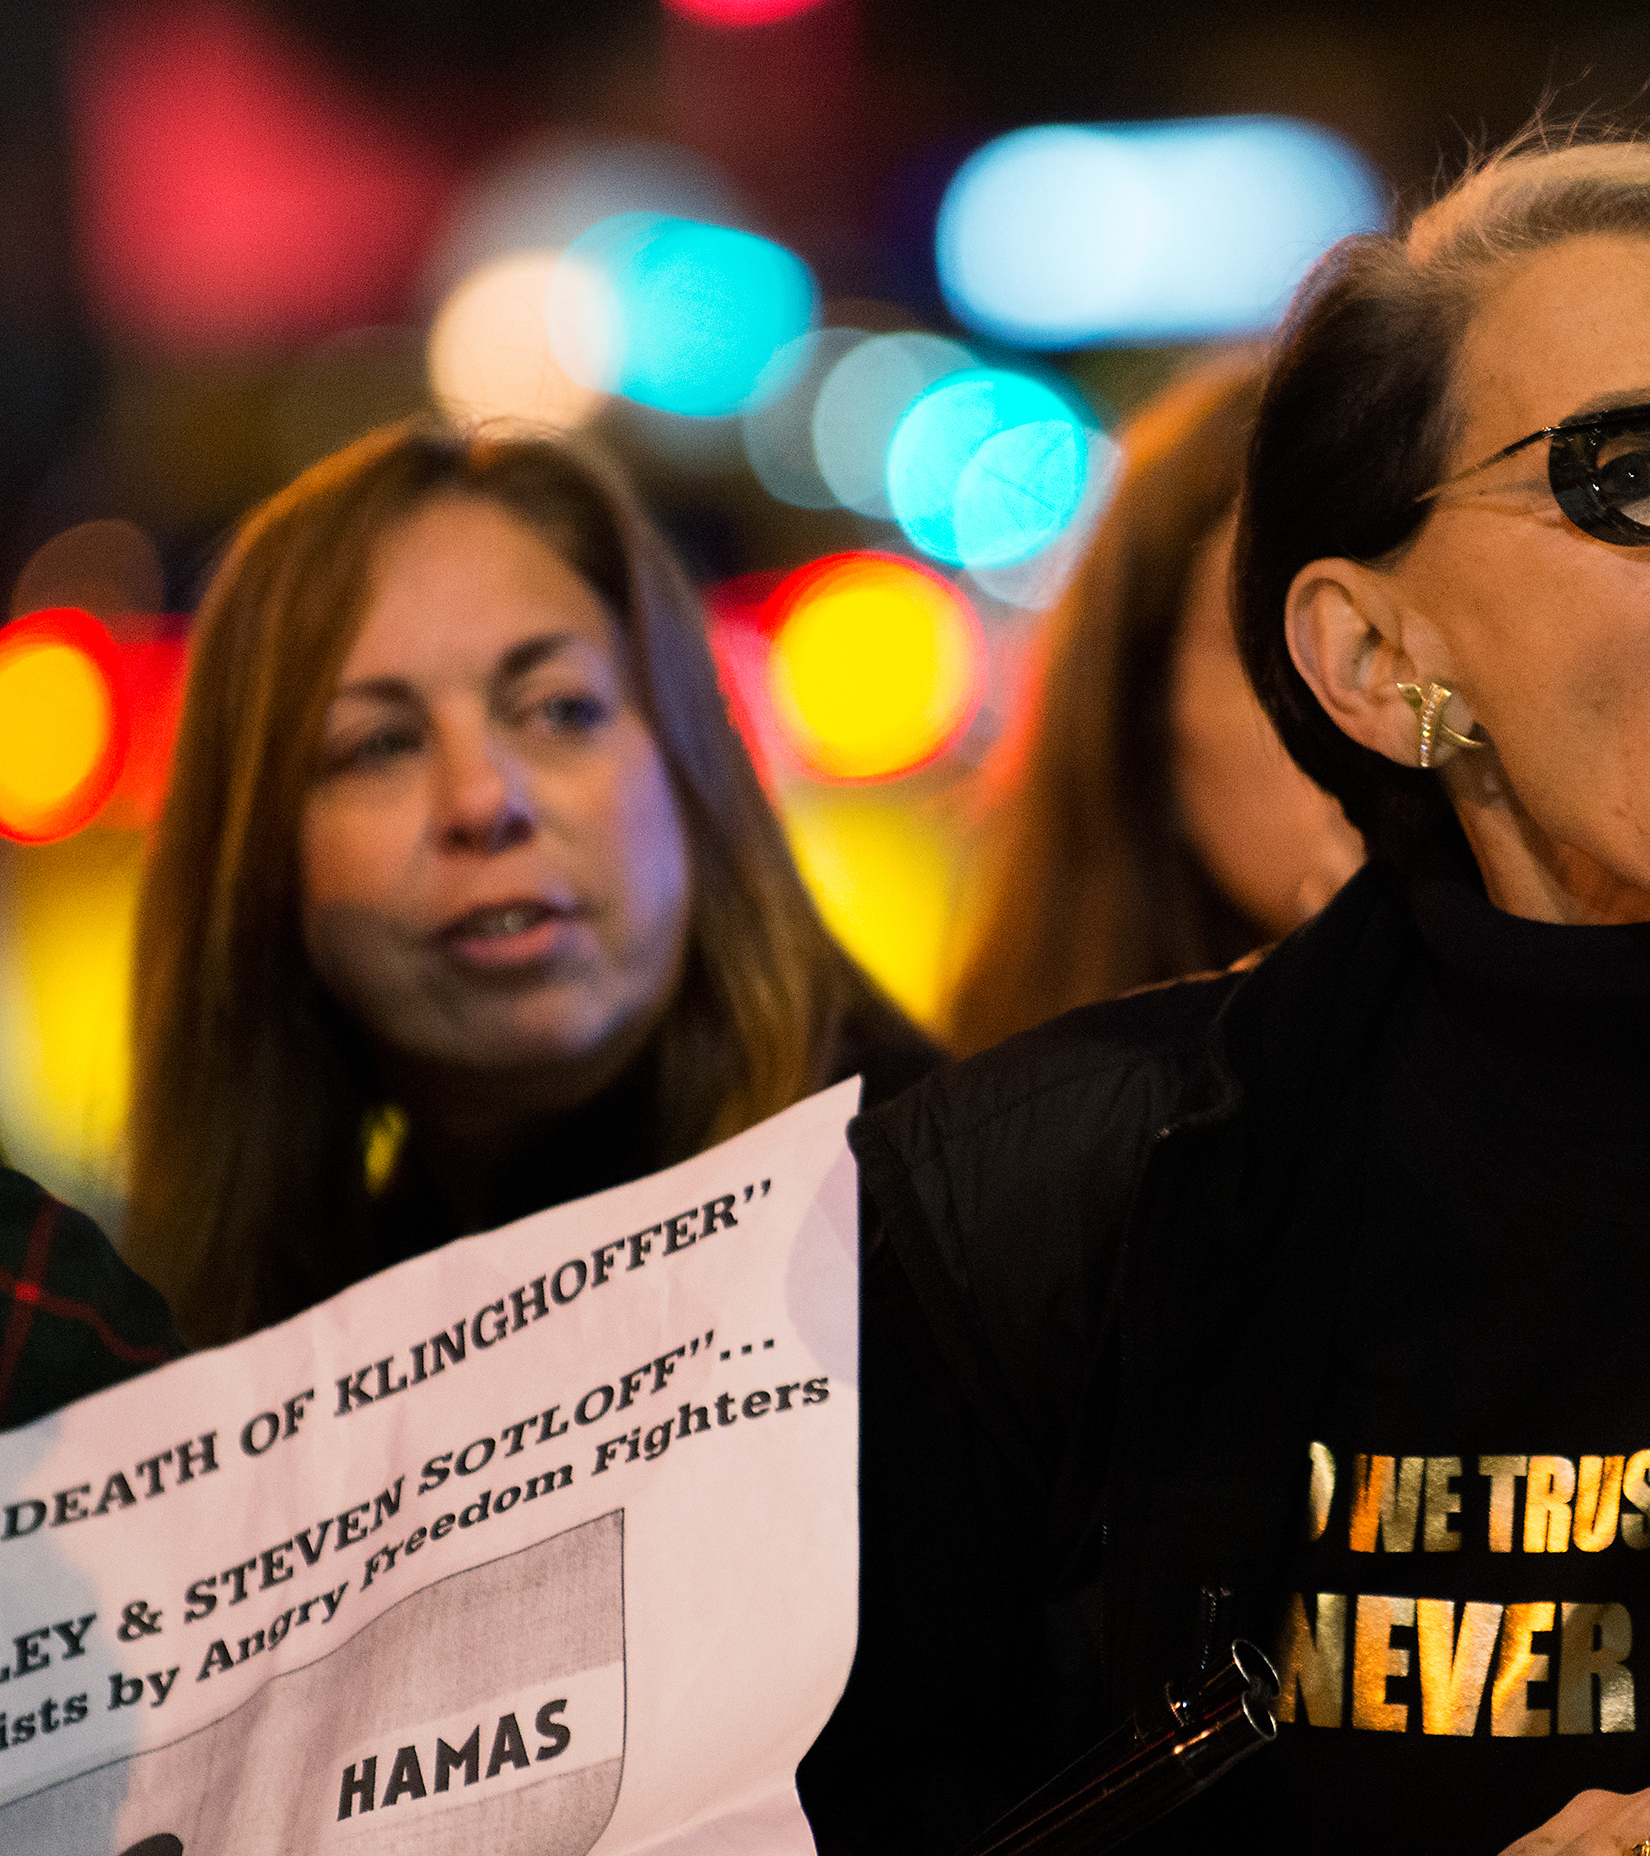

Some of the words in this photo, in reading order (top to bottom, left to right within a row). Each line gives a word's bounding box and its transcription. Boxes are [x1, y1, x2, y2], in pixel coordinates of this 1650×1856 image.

[0, 1430, 219, 1541] DEATH
[239, 1388, 315, 1457] OF
[1348, 1452, 1463, 1554] WE
[107, 1666, 180, 1710] by
[196, 1581, 349, 1683] Angry
[360, 1462, 573, 1592] Freedom
[591, 1375, 830, 1476] Fighters
[116, 1600, 163, 1643] &
[183, 1476, 406, 1625] STEVEN
[1276, 1592, 1638, 1738] NEVER
[336, 1698, 571, 1822] HAMAS
